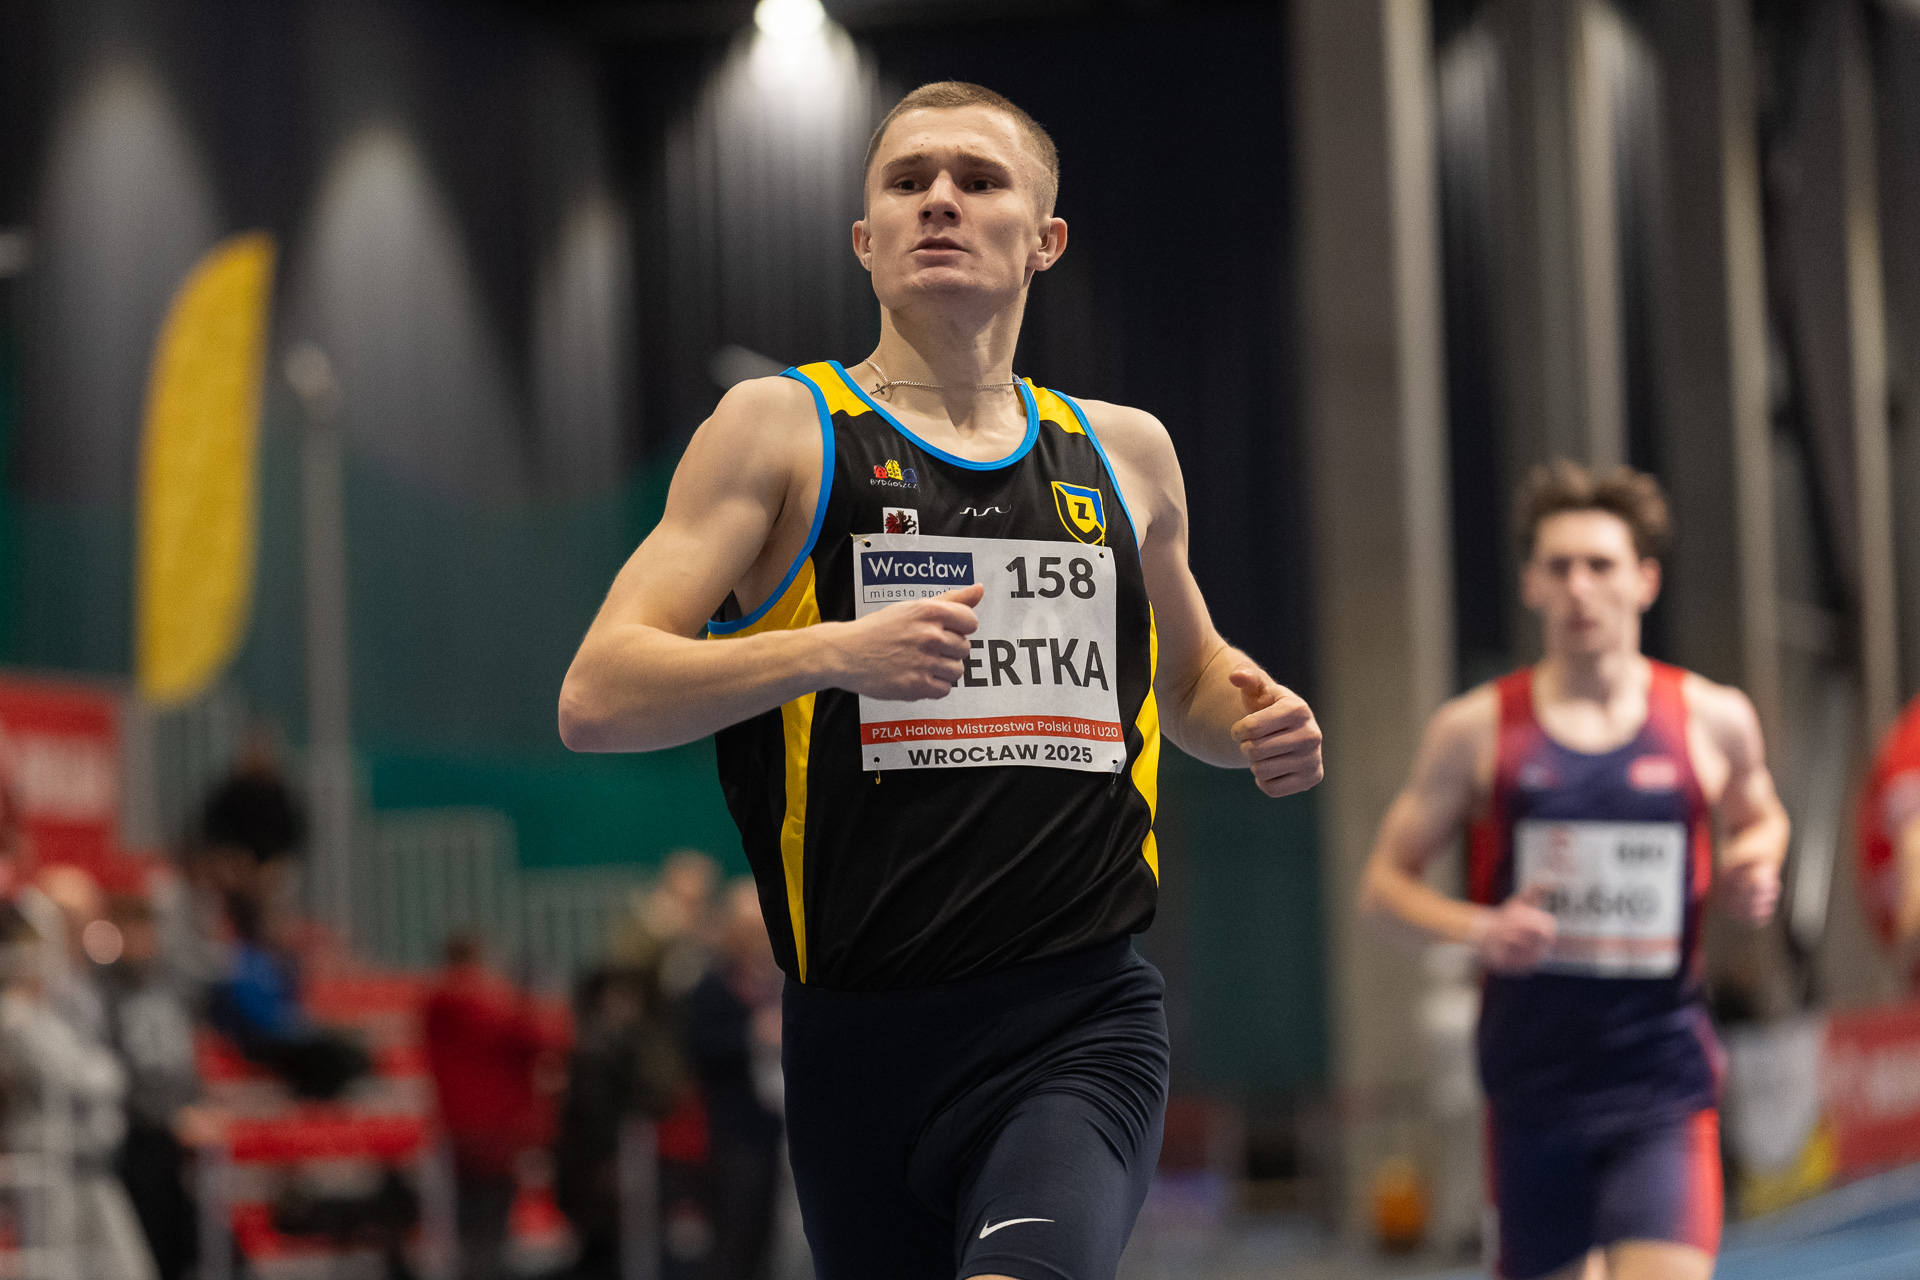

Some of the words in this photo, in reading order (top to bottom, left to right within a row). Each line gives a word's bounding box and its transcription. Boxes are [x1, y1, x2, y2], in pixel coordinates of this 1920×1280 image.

[870, 478, 919, 490] BYDGOSZCZ
[867, 556, 968, 579] Wrocław
[1005, 556, 1096, 600] 158
[870, 588, 915, 599] miasto
[951, 638, 1109, 691] ERTKA
[872, 727, 902, 739] PZLA
[905, 725, 953, 737] Halowe
[957, 722, 1034, 735] Mistrzostwa
[1038, 721, 1072, 733] Polski
[1074, 723, 1090, 735] U18
[1092, 725, 1096, 735] i
[1097, 727, 1118, 738] U20
[908, 744, 1038, 766] WROCŁAW
[1044, 744, 1093, 763] 2025
